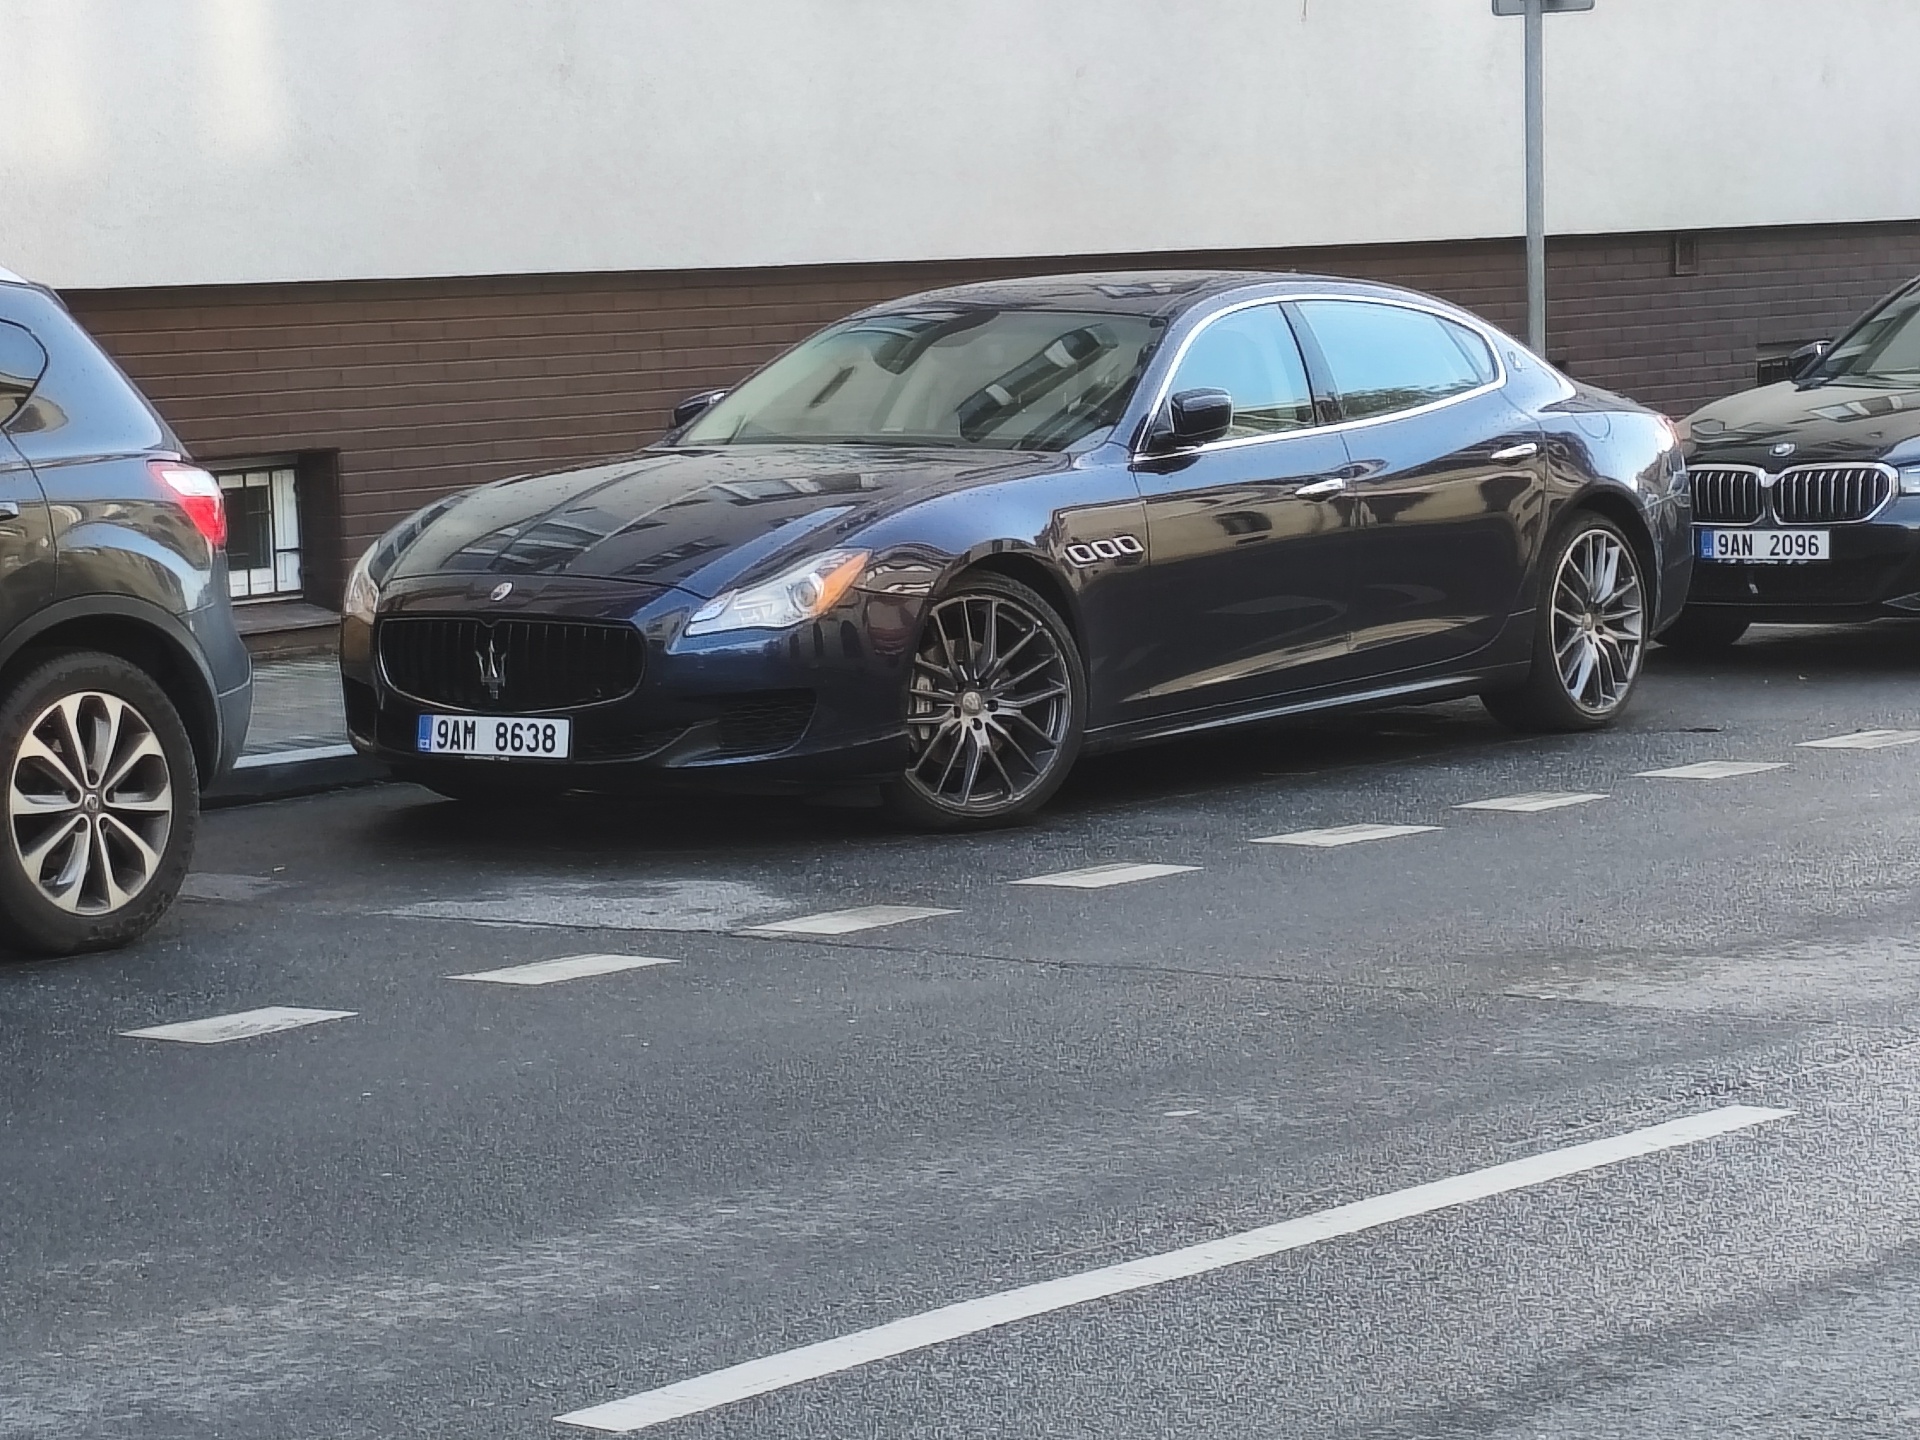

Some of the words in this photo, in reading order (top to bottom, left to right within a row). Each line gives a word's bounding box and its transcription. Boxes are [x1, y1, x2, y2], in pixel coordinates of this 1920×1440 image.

[1718, 533, 1753, 556] 9AN
[1769, 534, 1819, 556] 2096
[436, 719, 476, 750] 9AM
[495, 722, 556, 753] 8638
